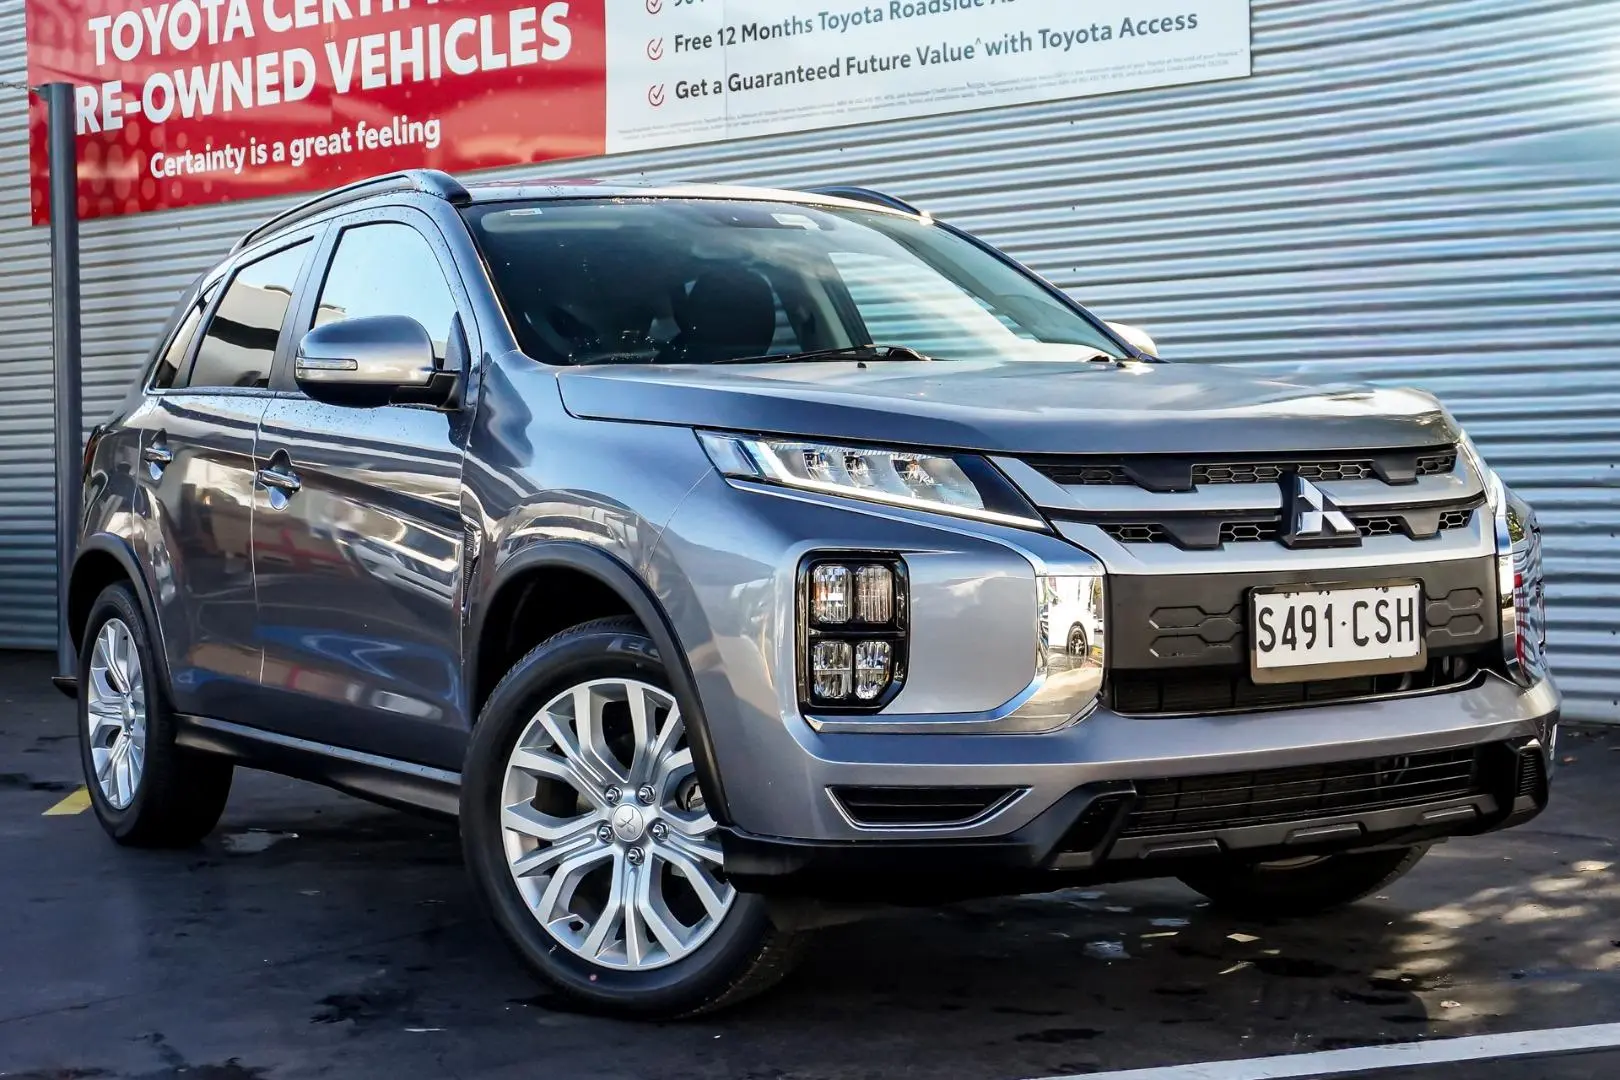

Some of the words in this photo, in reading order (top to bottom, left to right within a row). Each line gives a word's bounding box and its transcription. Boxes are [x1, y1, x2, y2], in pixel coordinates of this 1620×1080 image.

[88, 0, 255, 66] TOYOTA
[674, 34, 713, 53] Free
[717, 26, 737, 47] 12
[741, 16, 813, 43] Months
[818, 5, 884, 32] Toyota
[675, 80, 709, 100] Get
[713, 79, 723, 94] a
[728, 58, 841, 92] Guaranteed
[846, 50, 912, 76] Future
[985, 31, 1032, 57] with
[1038, 22, 1113, 52] Toyota
[1119, 12, 1198, 39] Access
[75, 48, 316, 136] RE-OWNED
[324, 2, 572, 94] VEHICLES
[150, 147, 245, 179] Certainty
[250, 136, 267, 165] is
[272, 141, 285, 162] a
[289, 126, 353, 167] great
[356, 115, 441, 149] feeling
